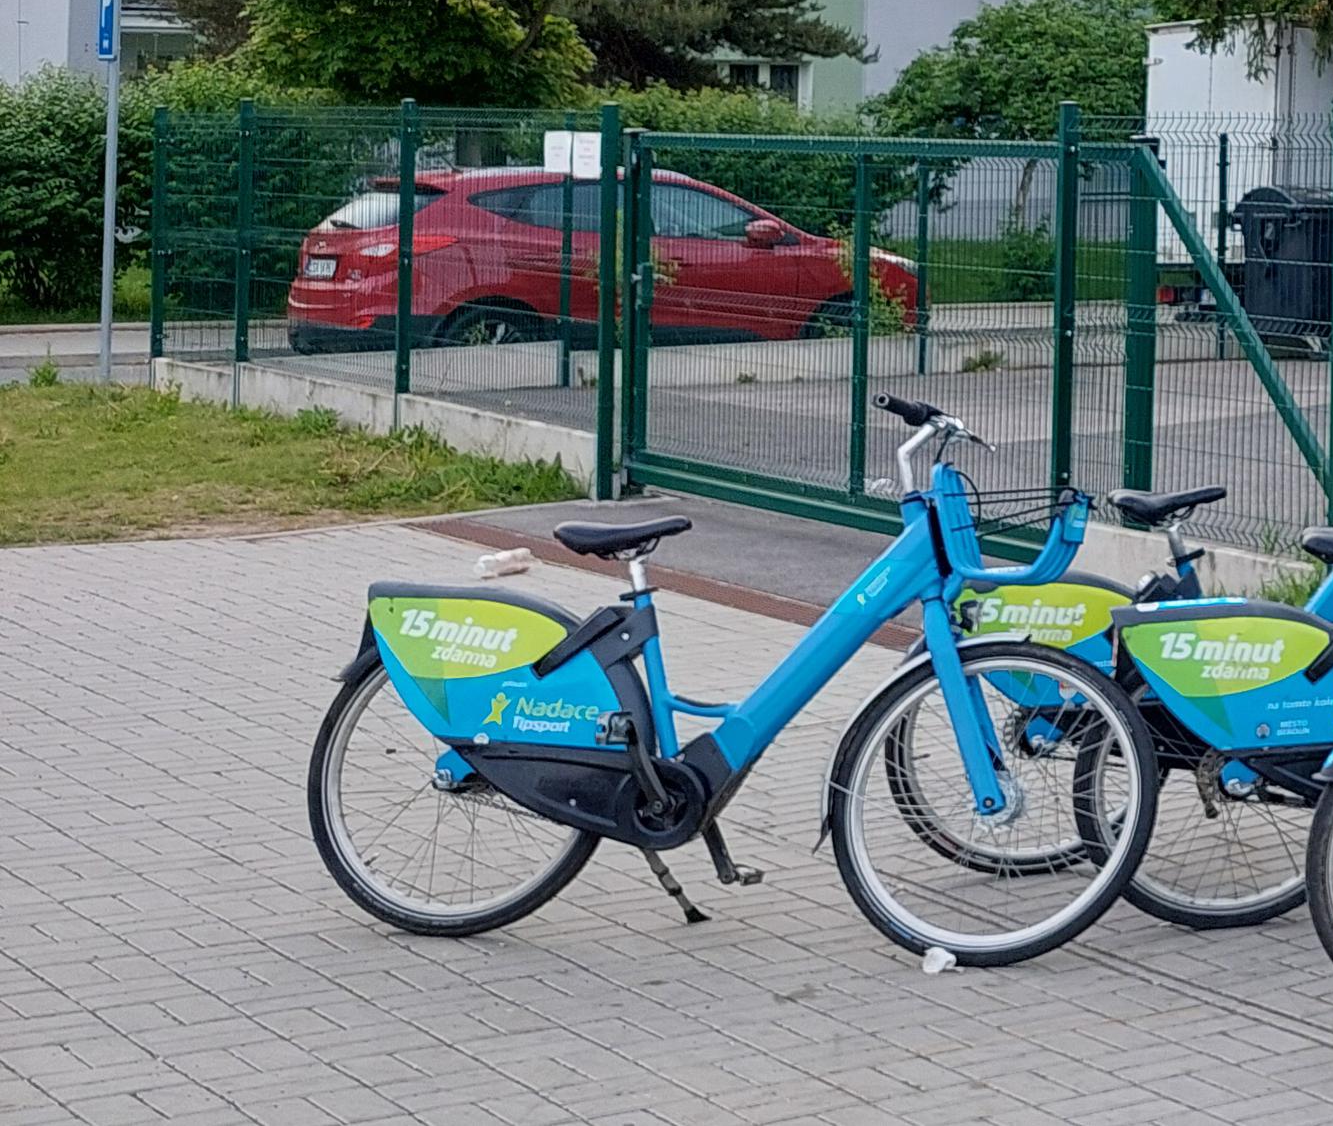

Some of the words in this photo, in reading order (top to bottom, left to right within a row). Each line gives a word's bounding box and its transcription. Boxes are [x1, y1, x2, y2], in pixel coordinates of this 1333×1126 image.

[400, 609, 436, 638] 15
[428, 616, 518, 653] minut
[431, 643, 498, 669] zdarma
[1159, 632, 1196, 660] 15
[1193, 634, 1285, 664] minut
[1201, 662, 1270, 681] zdarma
[514, 697, 599, 721] Nadace
